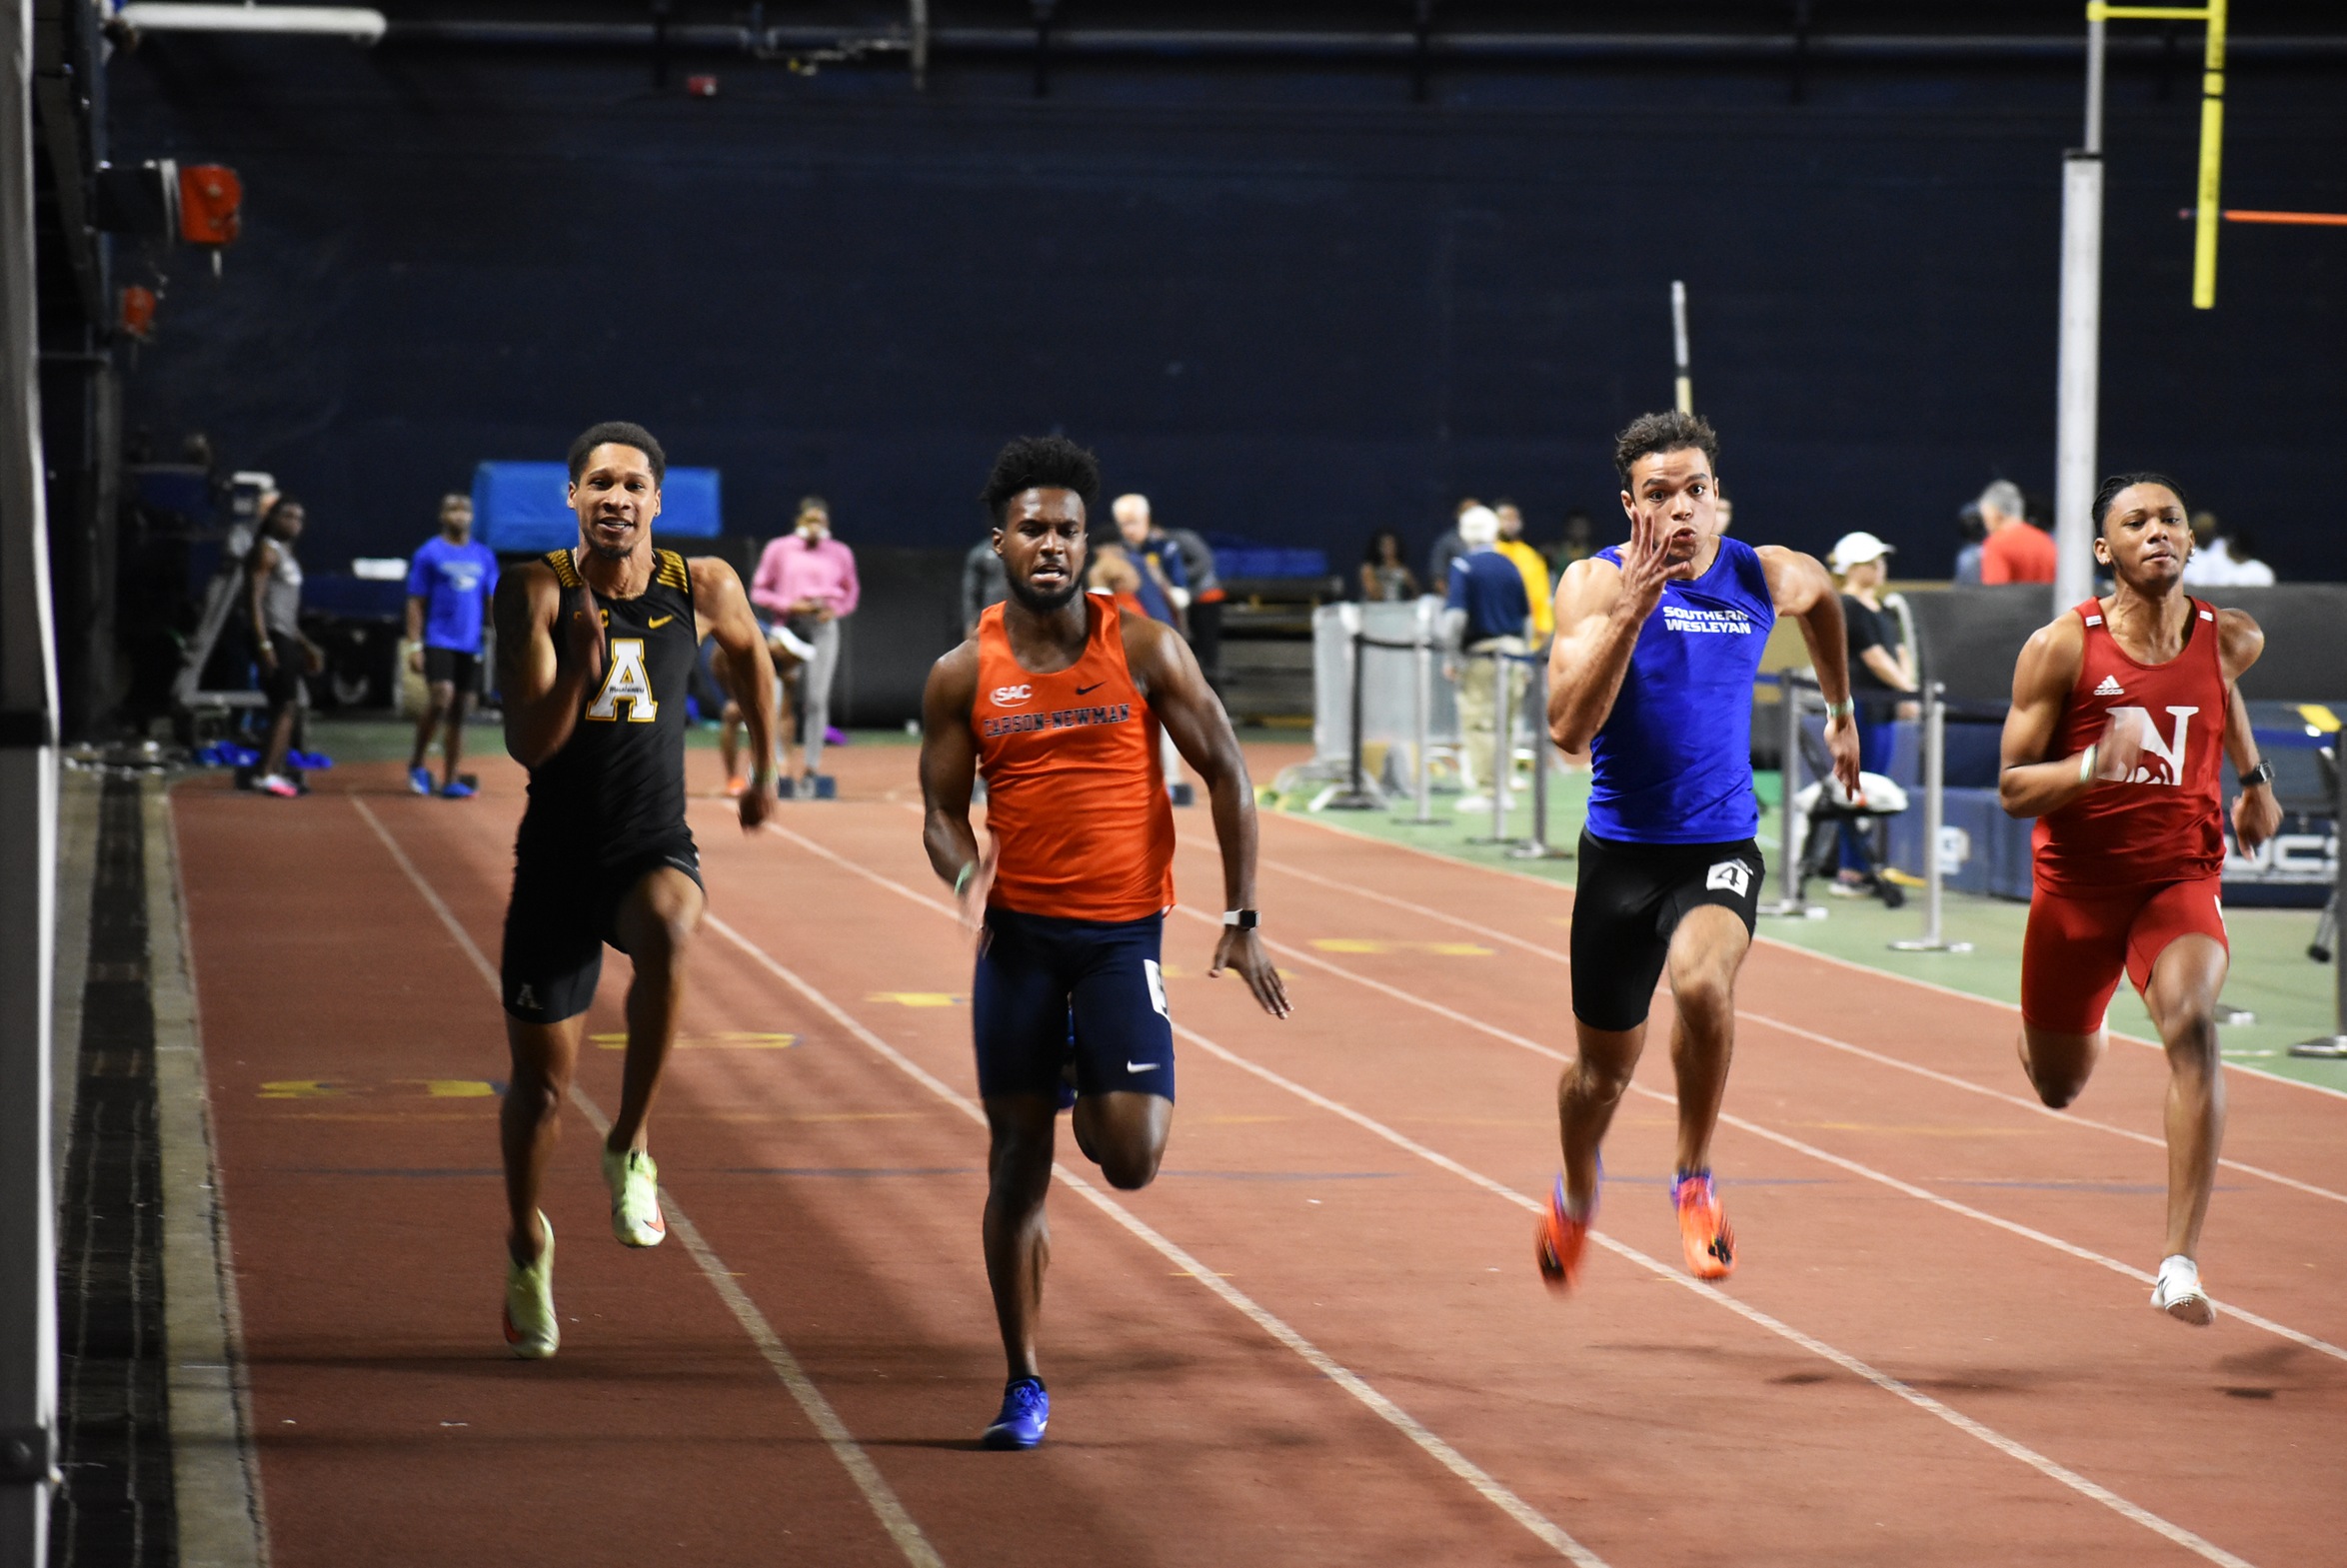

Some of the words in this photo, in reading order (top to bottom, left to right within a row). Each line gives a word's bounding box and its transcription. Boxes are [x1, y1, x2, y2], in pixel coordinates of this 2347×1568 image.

[1662, 606, 1748, 621] SOUTHERN
[1664, 619, 1751, 635] WESLEYAN
[585, 638, 658, 722] A
[995, 684, 1033, 702] SAC
[984, 703, 1130, 738] CARSON-NEWMAN
[2097, 706, 2199, 785] N
[2221, 834, 2340, 871] UC
[1715, 866, 1740, 887] 4
